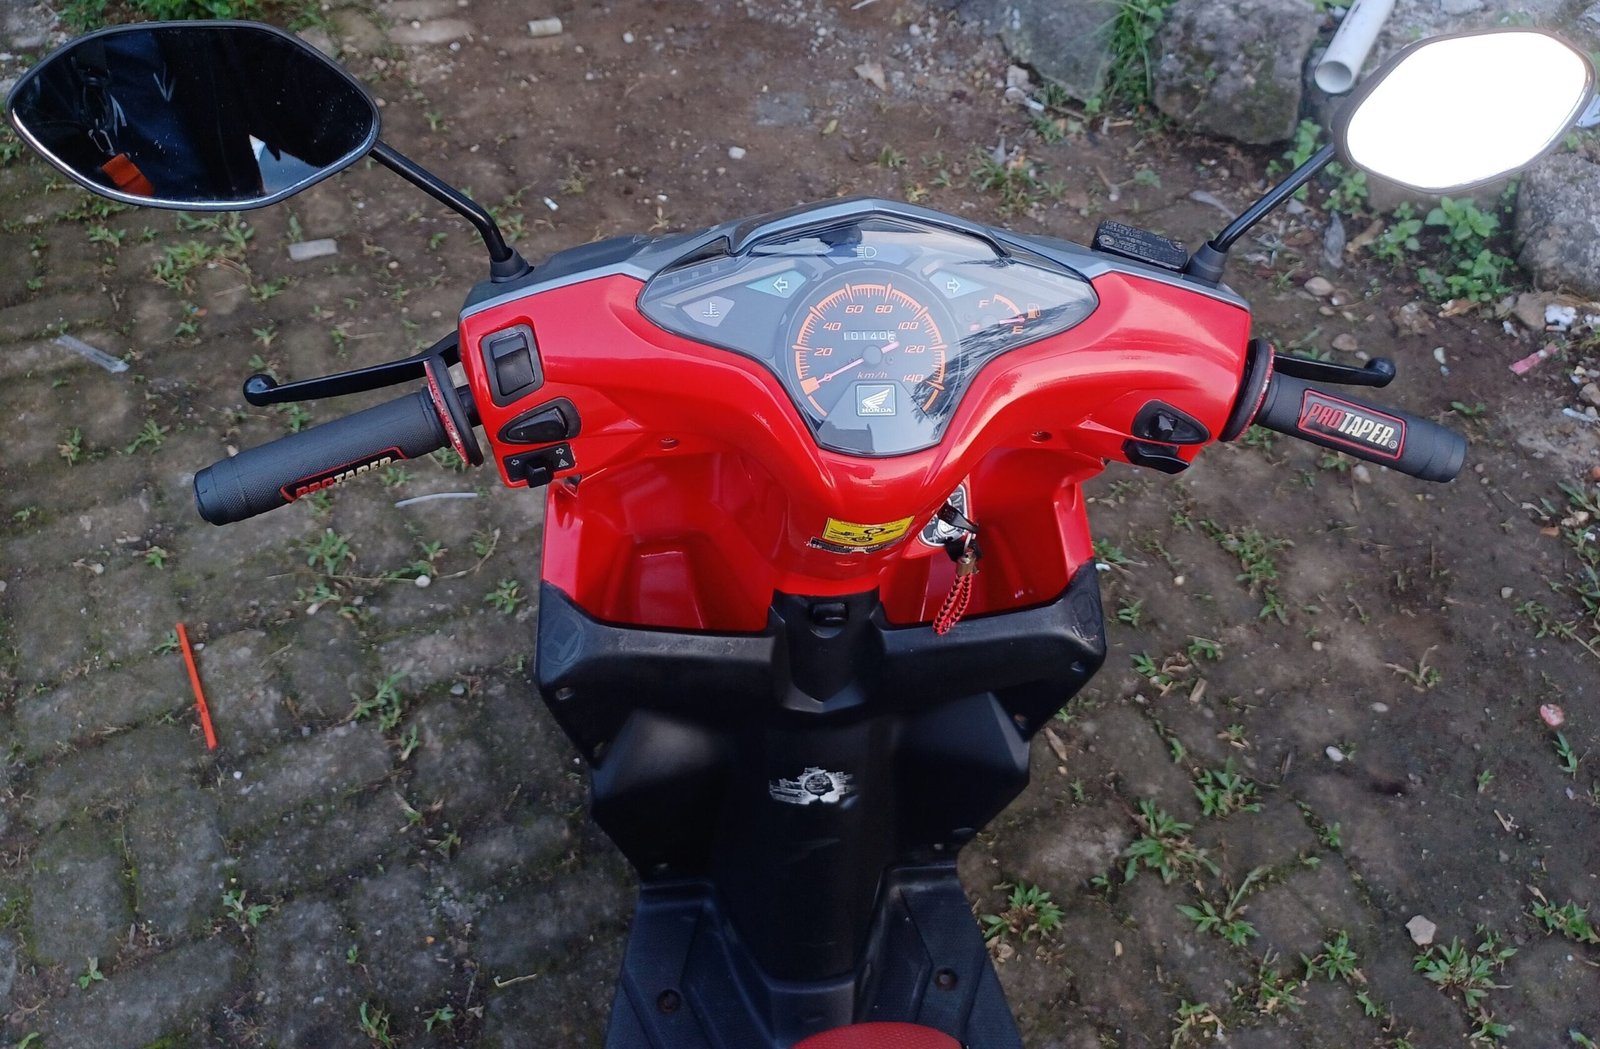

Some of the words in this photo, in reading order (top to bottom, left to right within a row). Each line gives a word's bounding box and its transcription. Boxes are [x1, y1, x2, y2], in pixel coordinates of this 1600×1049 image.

[978, 299, 990, 309] F
[845, 304, 864, 314] 60
[875, 304, 893, 314] 80
[823, 322, 842, 331] 40
[897, 321, 919, 330] 100
[1011, 325, 1024, 335] E
[813, 347, 833, 356] 20
[904, 345, 926, 354] 120
[857, 371, 888, 380] km/h
[902, 374, 925, 383] 140
